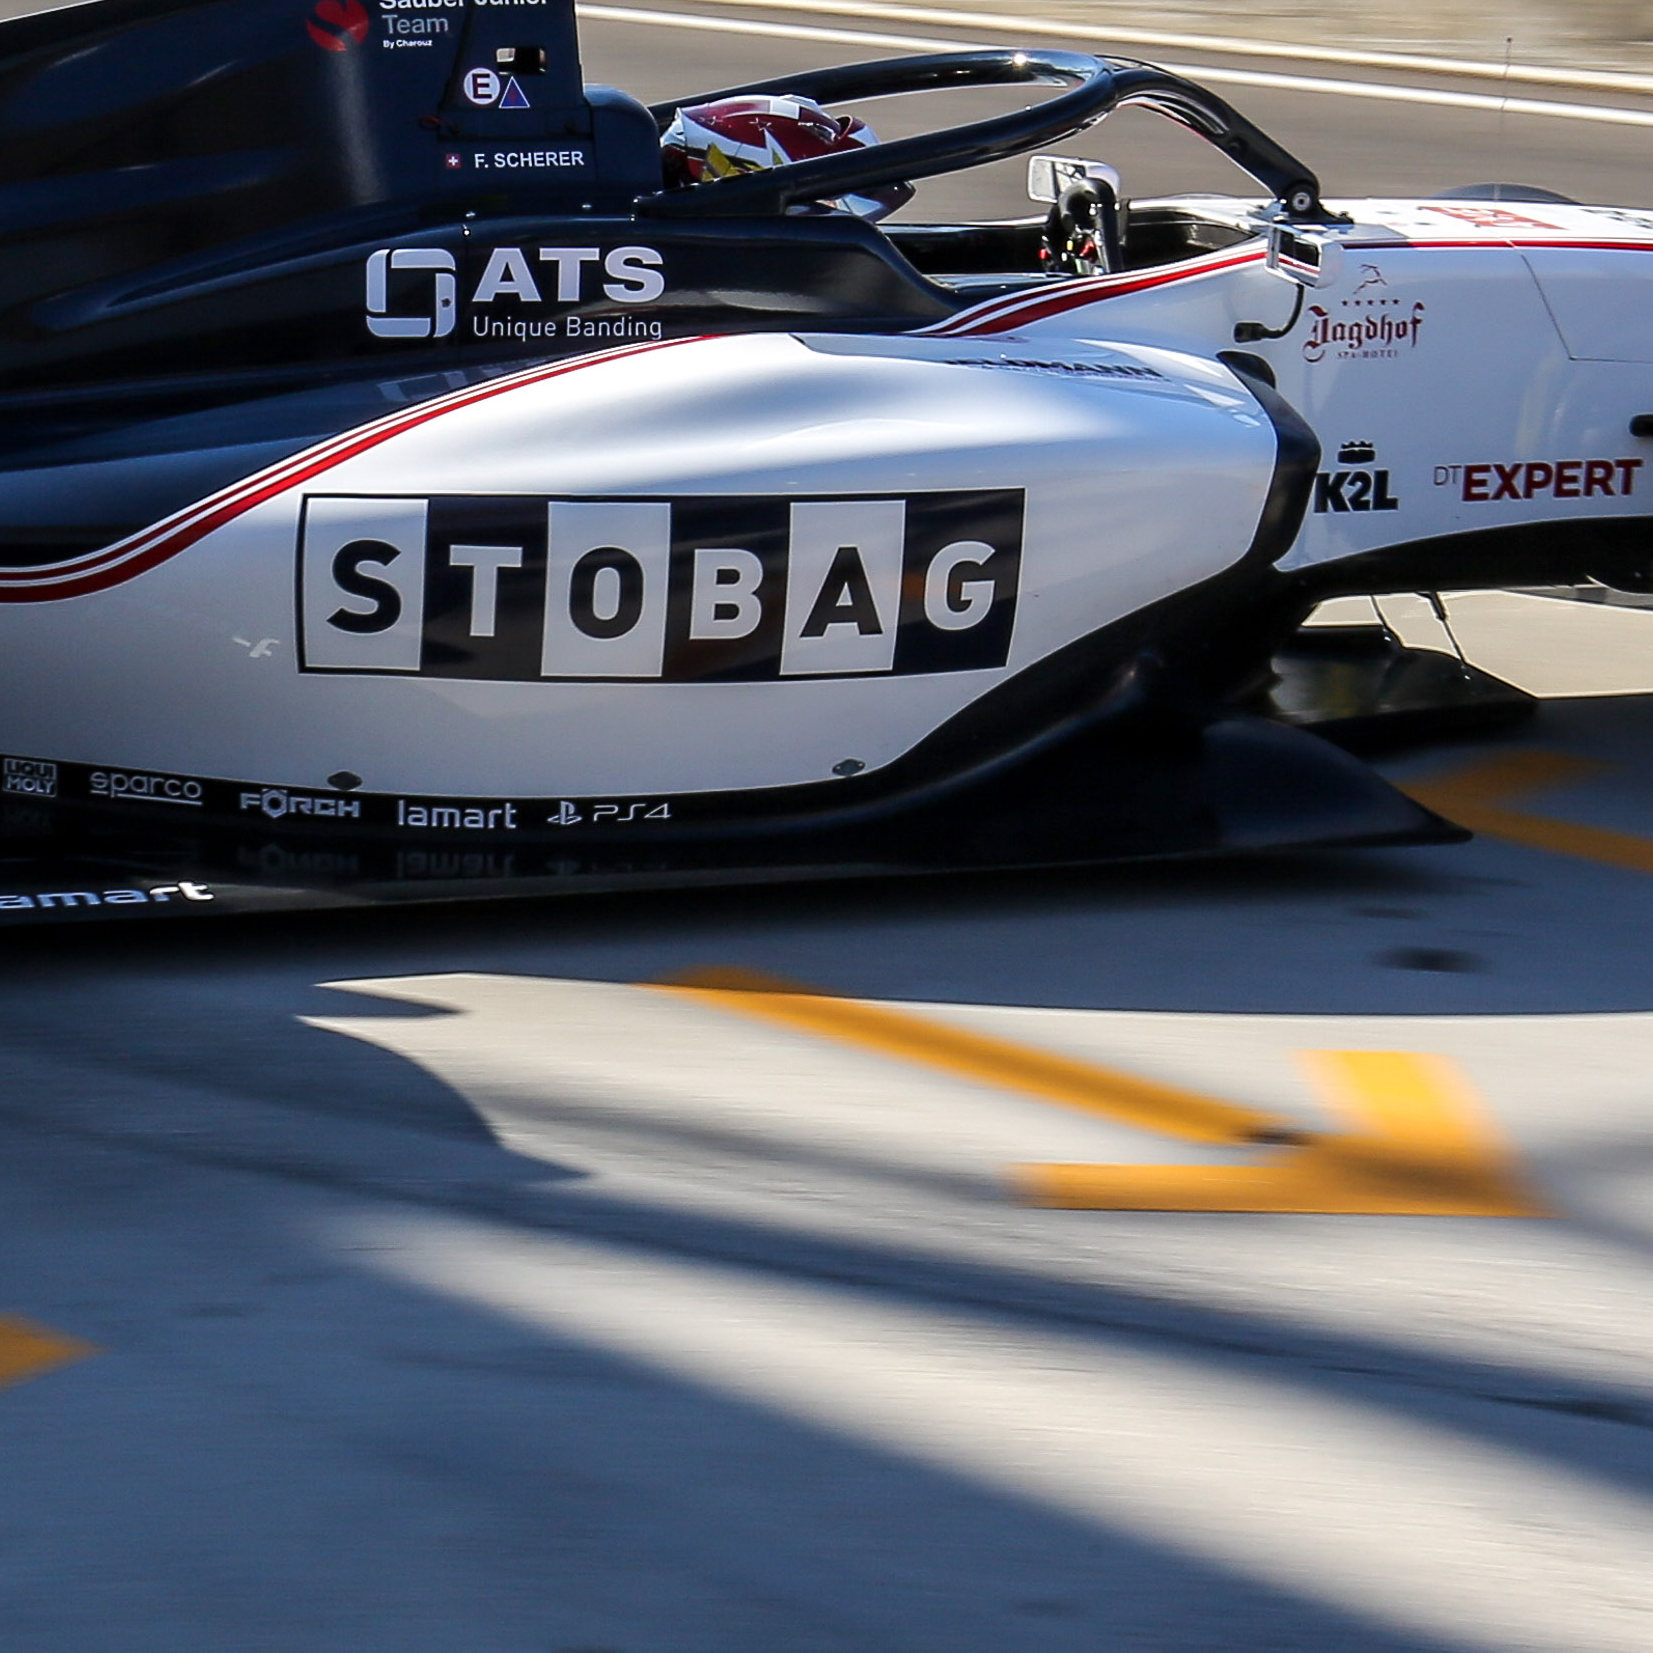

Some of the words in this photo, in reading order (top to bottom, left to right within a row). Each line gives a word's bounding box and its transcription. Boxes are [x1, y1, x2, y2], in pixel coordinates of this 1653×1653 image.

[382, 14, 449, 34] Team
[472, 73, 493, 99] E
[474, 153, 489, 168] F.
[494, 151, 585, 167] SCHERER
[471, 246, 665, 303] ATS
[473, 316, 557, 341] Unique
[566, 316, 662, 339] Banding
[1303, 302, 1425, 362] Jagdhof
[1314, 470, 1399, 514] K2L
[326, 538, 996, 640] STOBAG
[7, 776, 54, 794] MOLY
[90, 770, 203, 798] sparco
[398, 800, 517, 829] lamart
[593, 803, 672, 821] PS4
